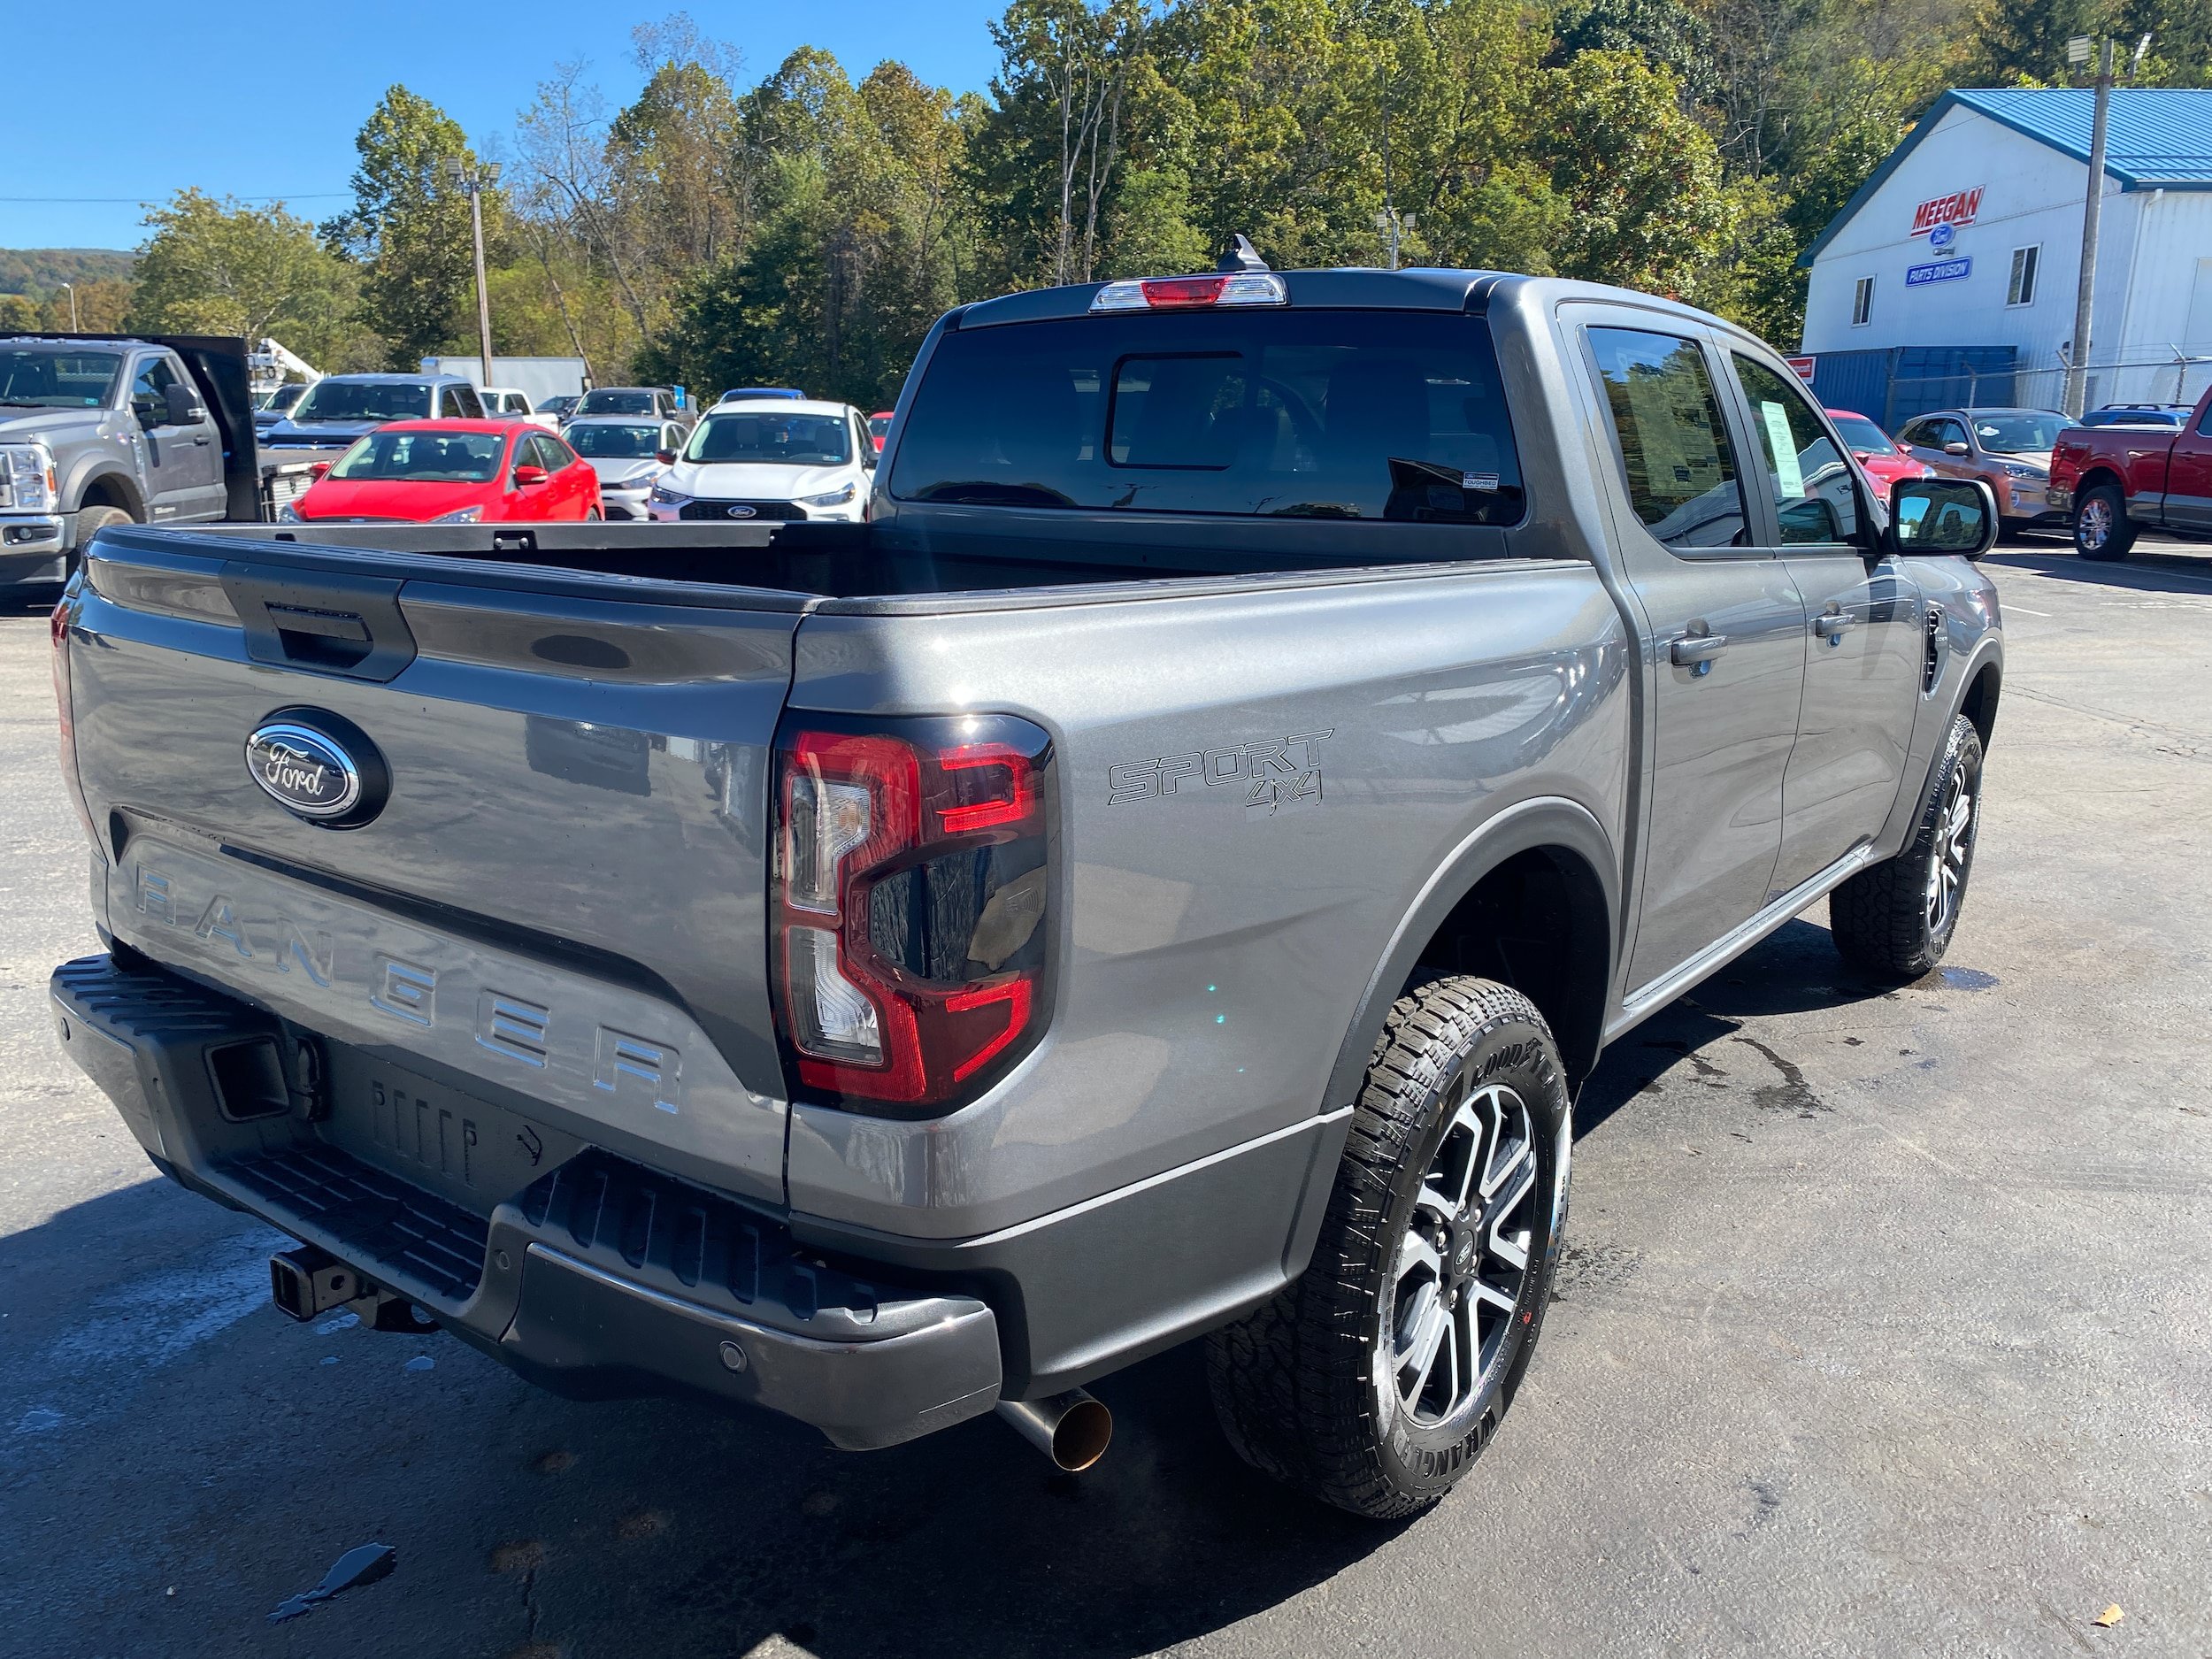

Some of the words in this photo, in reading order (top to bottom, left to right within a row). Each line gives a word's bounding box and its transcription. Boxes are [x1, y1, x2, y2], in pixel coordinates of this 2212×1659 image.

[1912, 188, 1982, 229] MEEGAN
[1909, 268, 1933, 282] PARTS
[1933, 262, 1969, 279] DIVISION
[265, 741, 325, 796] Ford
[1107, 727, 1335, 806] SPORT
[135, 863, 681, 1115] RANGER
[1470, 1037, 1564, 1116] GOODYEAR
[1394, 1404, 1497, 1479] WRANGLER
